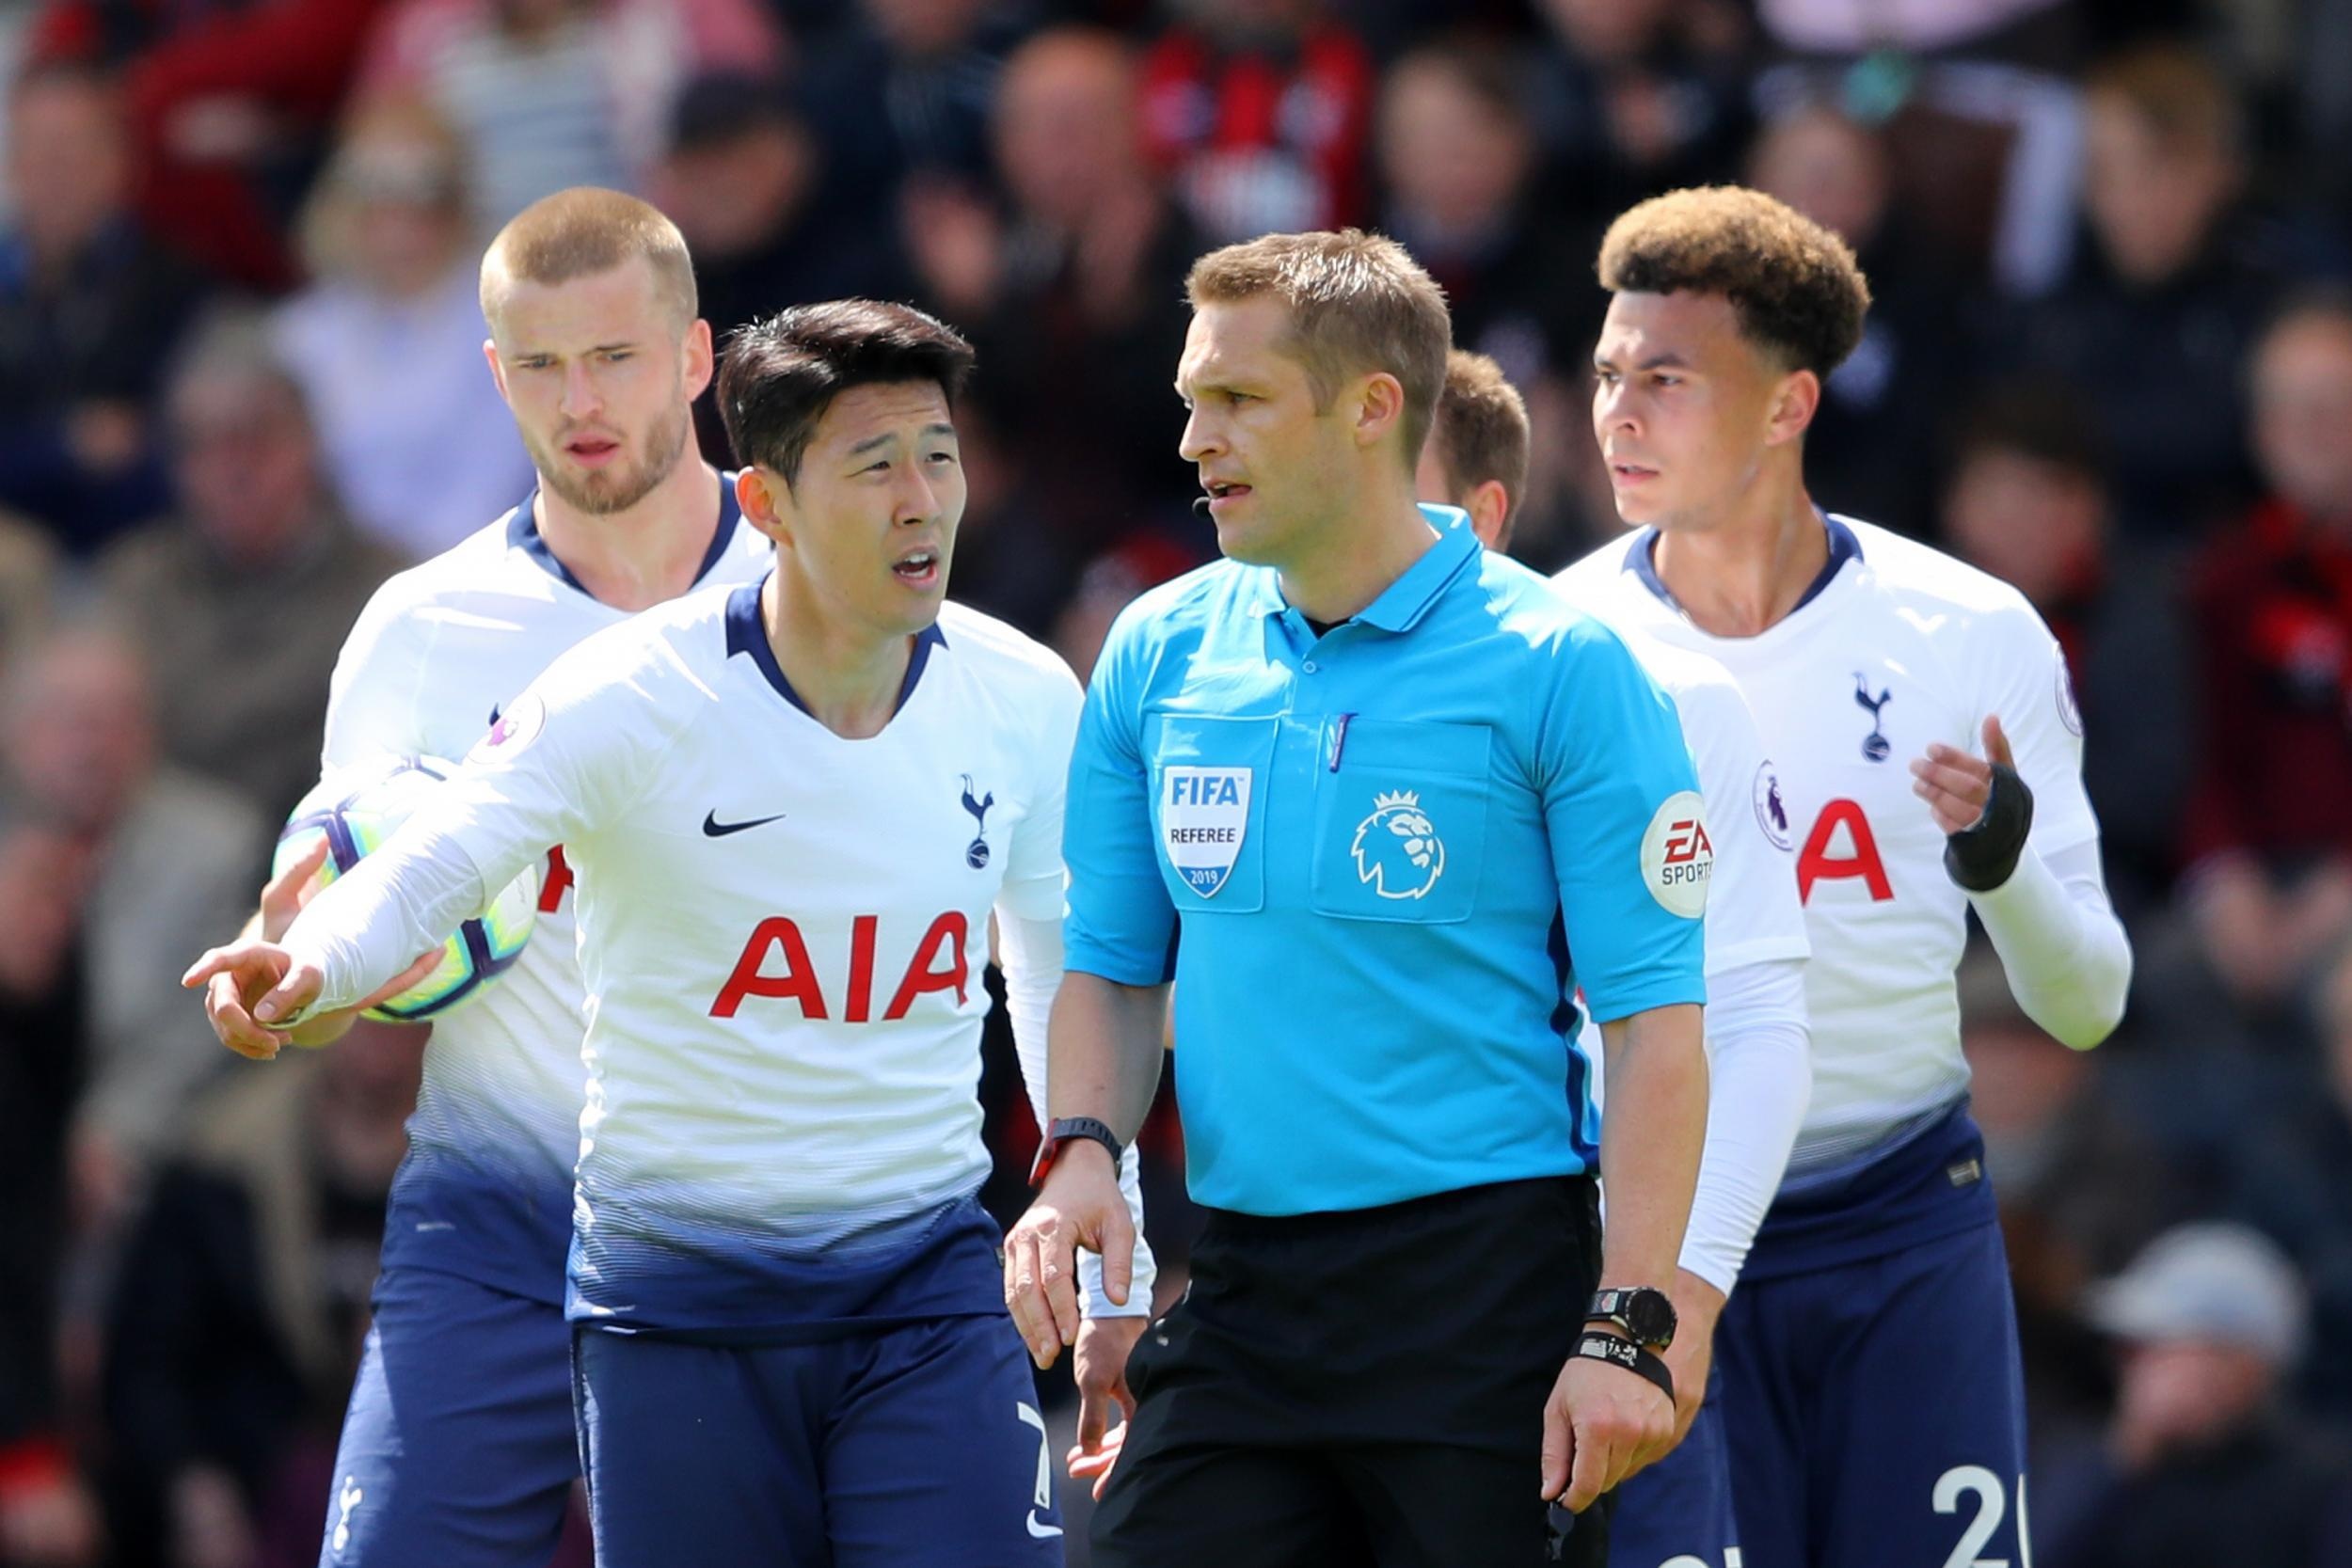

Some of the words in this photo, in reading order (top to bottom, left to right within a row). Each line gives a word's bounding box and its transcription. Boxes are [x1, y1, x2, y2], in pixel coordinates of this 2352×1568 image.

[1171, 776, 1240, 806] FIFA
[1170, 827, 1236, 844] REFEREE
[1663, 818, 1713, 864] EA
[1189, 869, 1219, 885] 2019
[708, 910, 968, 1023] AIA
[1016, 1401, 1051, 1510] 7
[1931, 1465, 2030, 1568] 2
